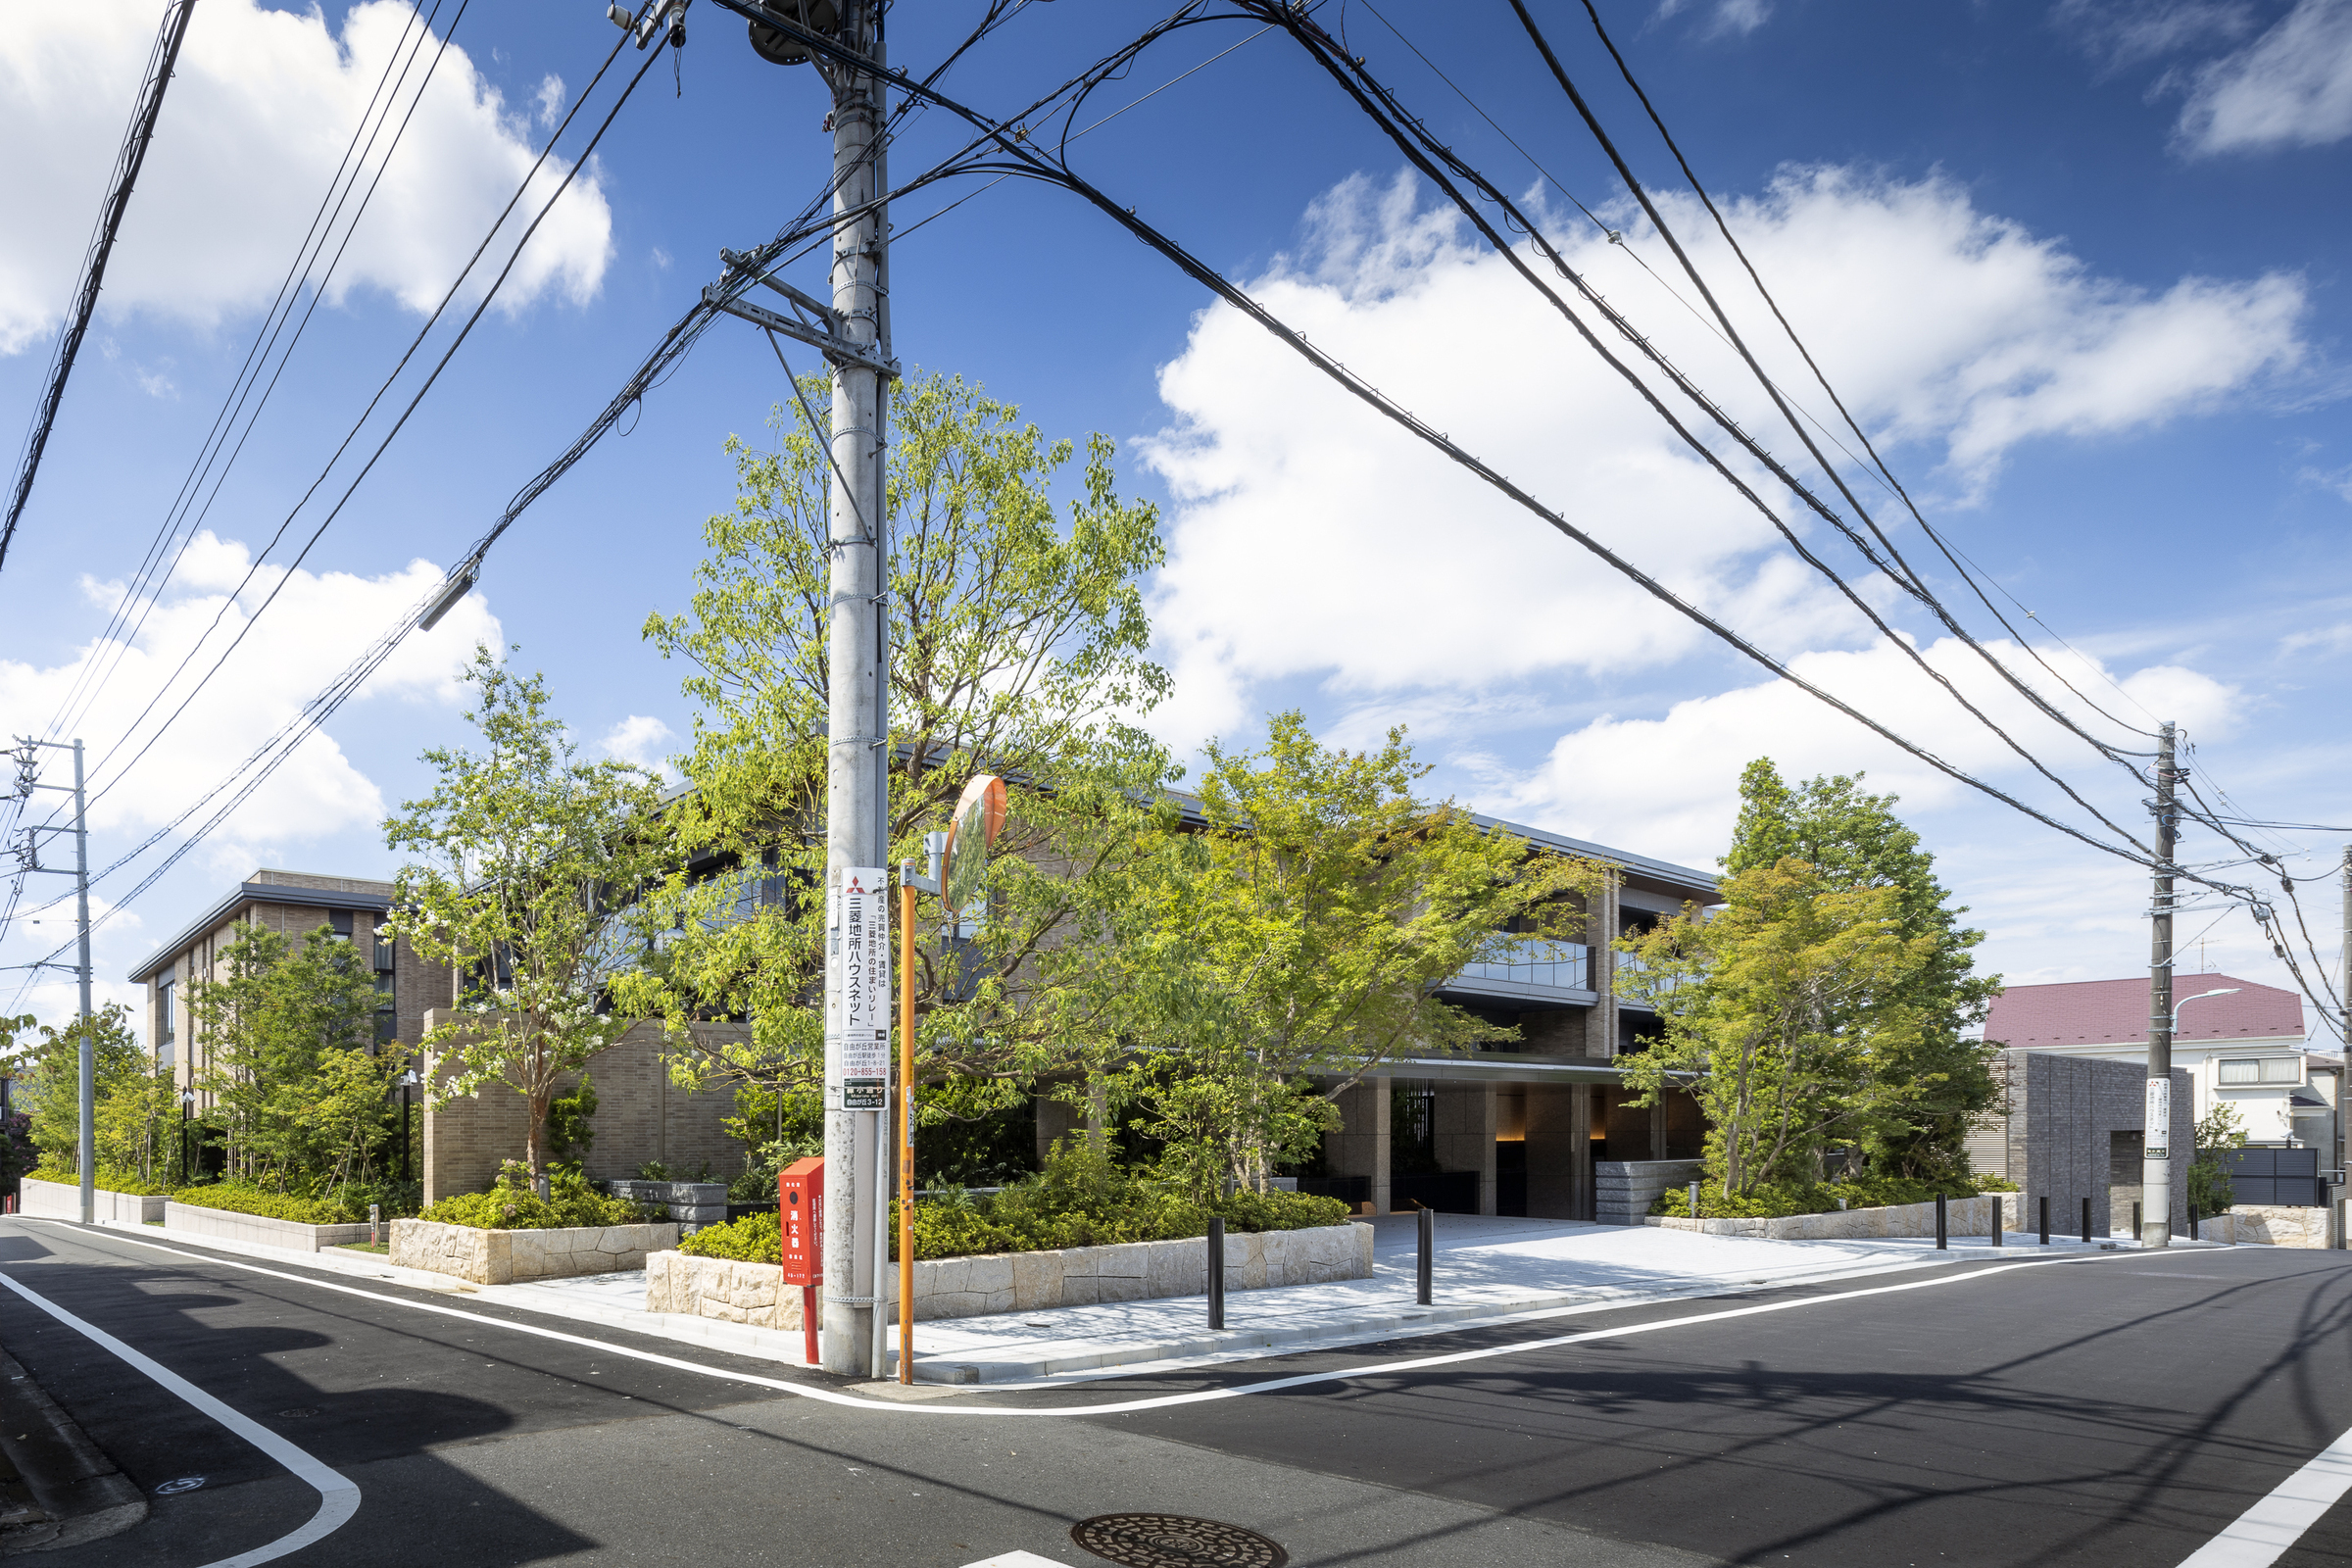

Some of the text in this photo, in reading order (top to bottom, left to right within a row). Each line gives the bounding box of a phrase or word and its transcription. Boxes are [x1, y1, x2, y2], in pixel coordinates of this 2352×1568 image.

[849, 898, 861, 1026] 三菱地所ハウスネット
[844, 1042, 886, 1052] 自由が丘営業所
[843, 1067, 887, 1076] 0120-855-158
[790, 1210, 799, 1249] 消火器
